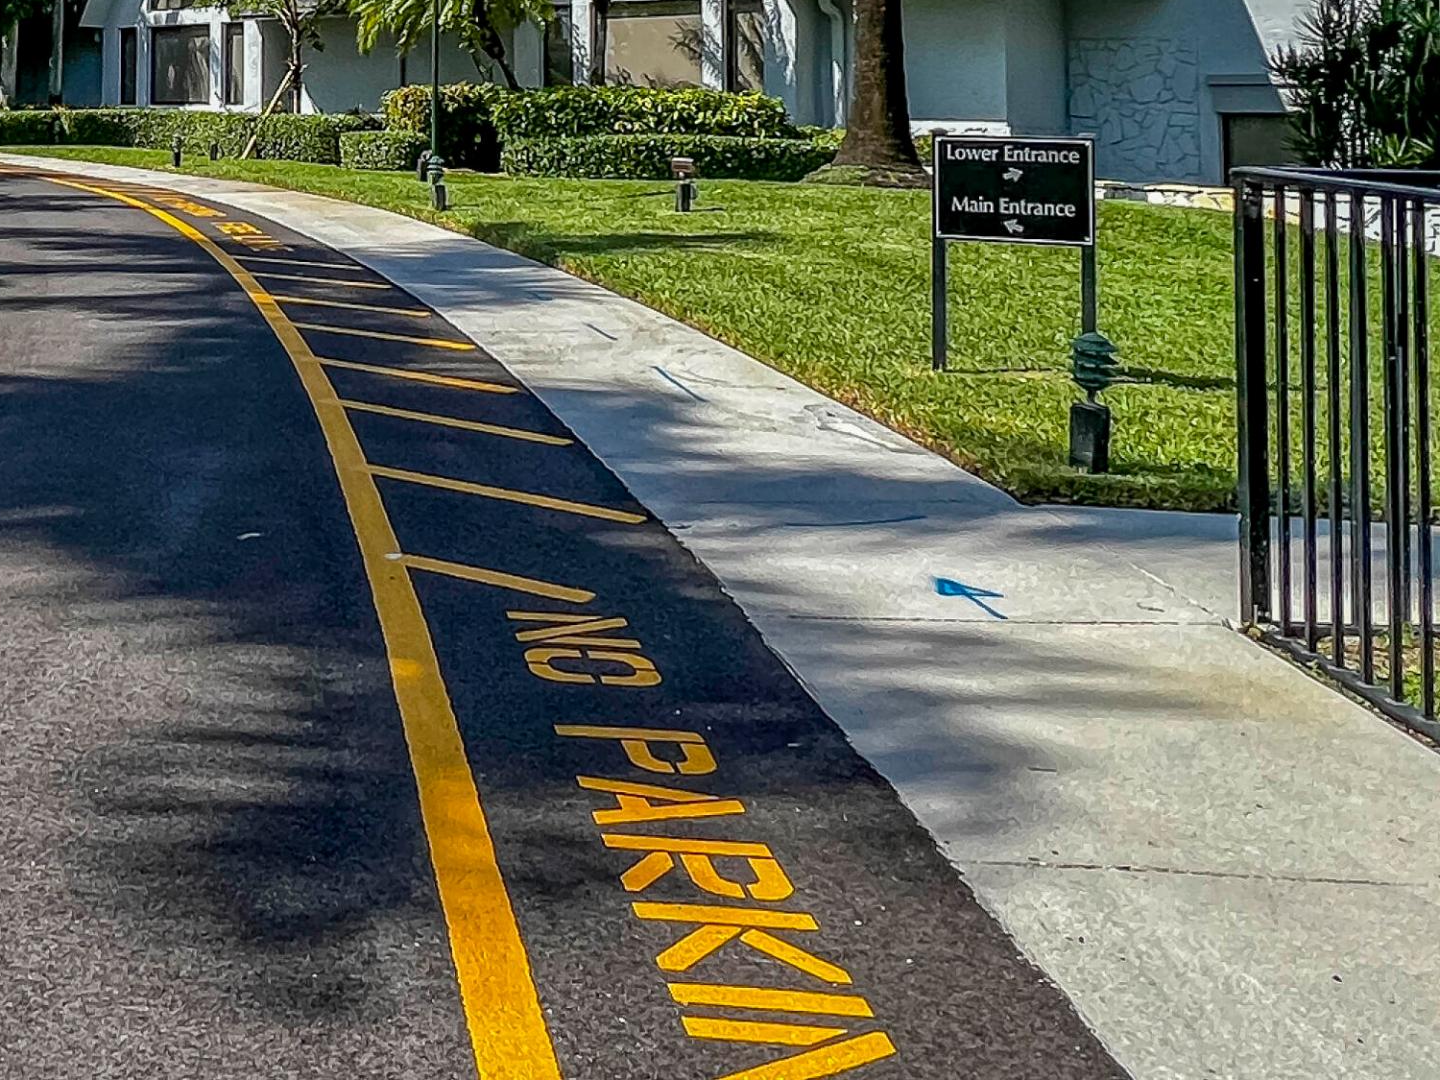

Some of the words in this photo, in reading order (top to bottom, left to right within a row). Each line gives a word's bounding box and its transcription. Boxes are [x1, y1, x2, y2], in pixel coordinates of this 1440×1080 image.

[947, 143, 999, 162] Lower
[1003, 145, 1081, 164] Entrance
[951, 196, 995, 214] Main
[998, 197, 1077, 218] Entrance
[506, 610, 662, 687] NO
